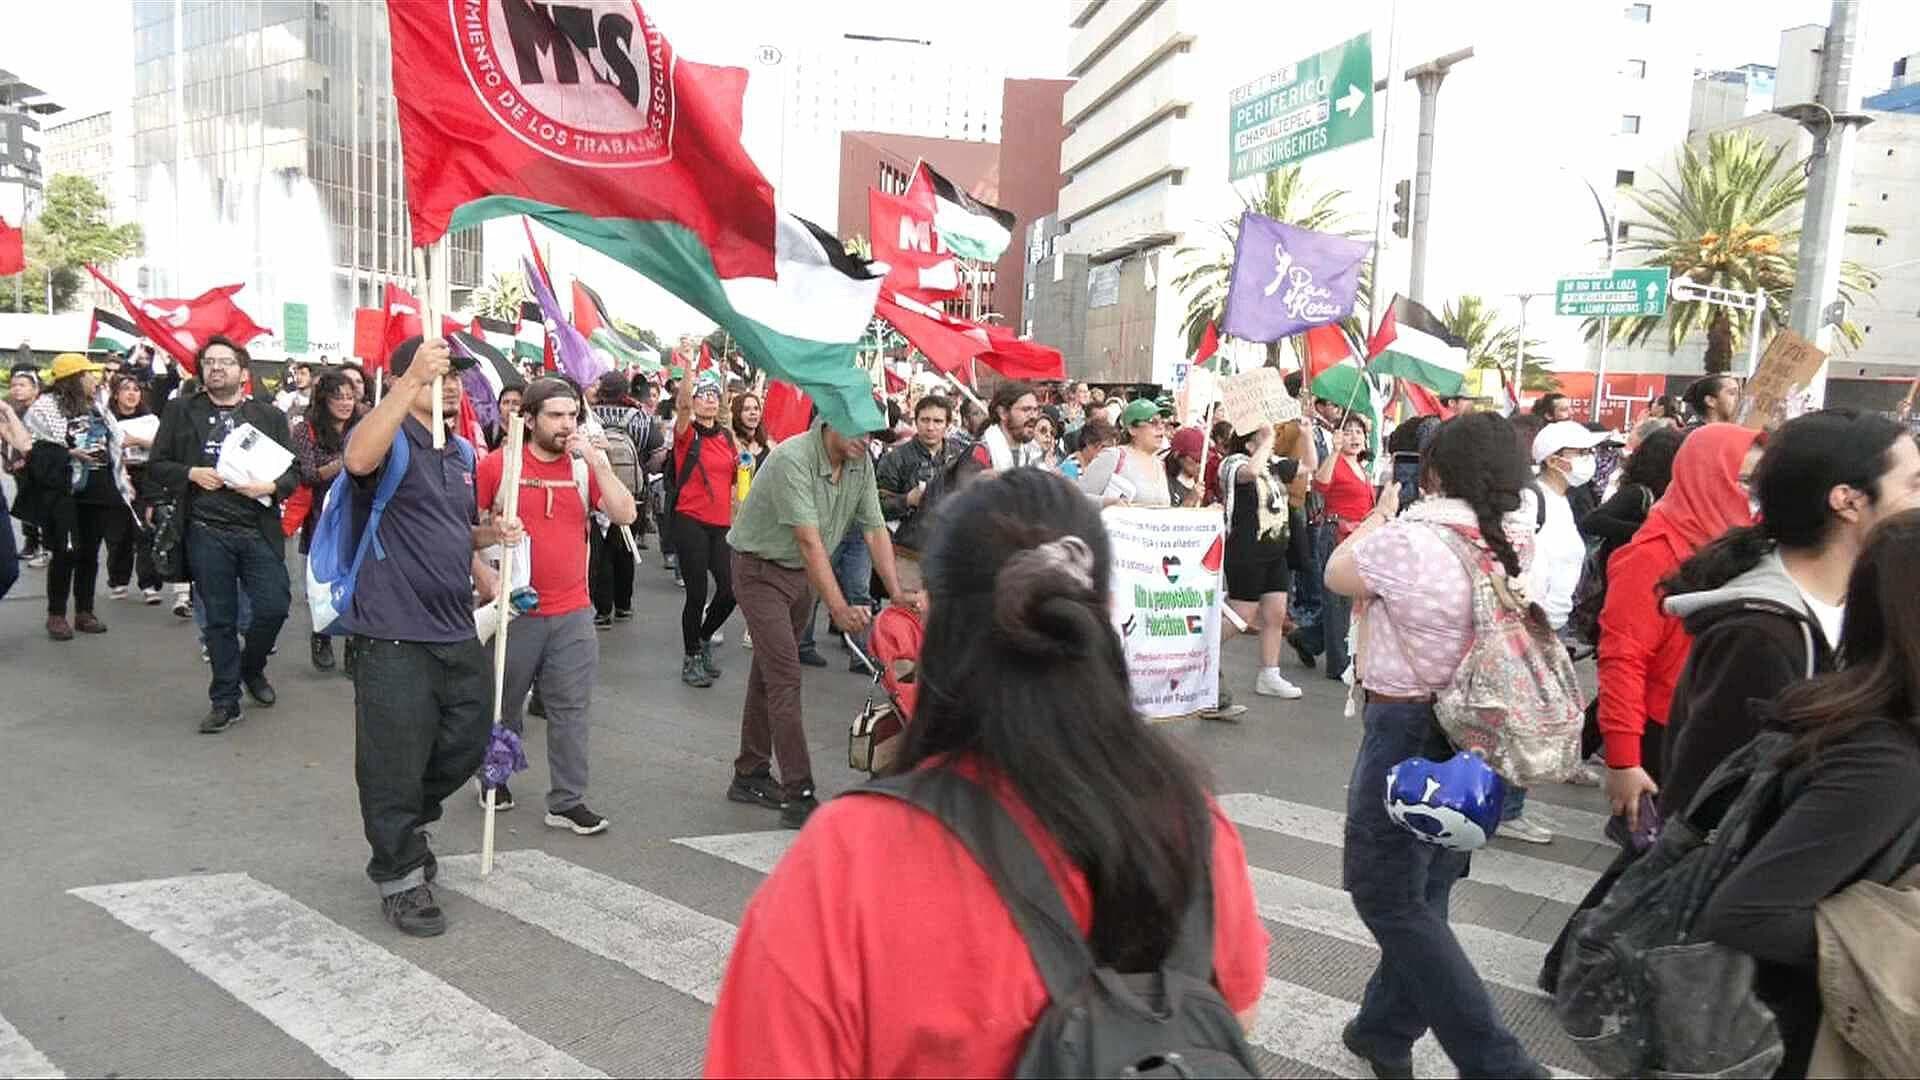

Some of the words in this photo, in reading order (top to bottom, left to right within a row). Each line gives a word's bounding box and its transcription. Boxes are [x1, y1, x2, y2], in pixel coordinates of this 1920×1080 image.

[499, 0, 640, 109] MTS
[498, 90, 528, 120] DE
[527, 115, 568, 146] LOS
[1236, 76, 1327, 128] PERIFERICO
[1239, 108, 1312, 148] CHAPULTEPEC
[1251, 126, 1328, 169] INSURGENTES
[1604, 280, 1616, 291] LA
